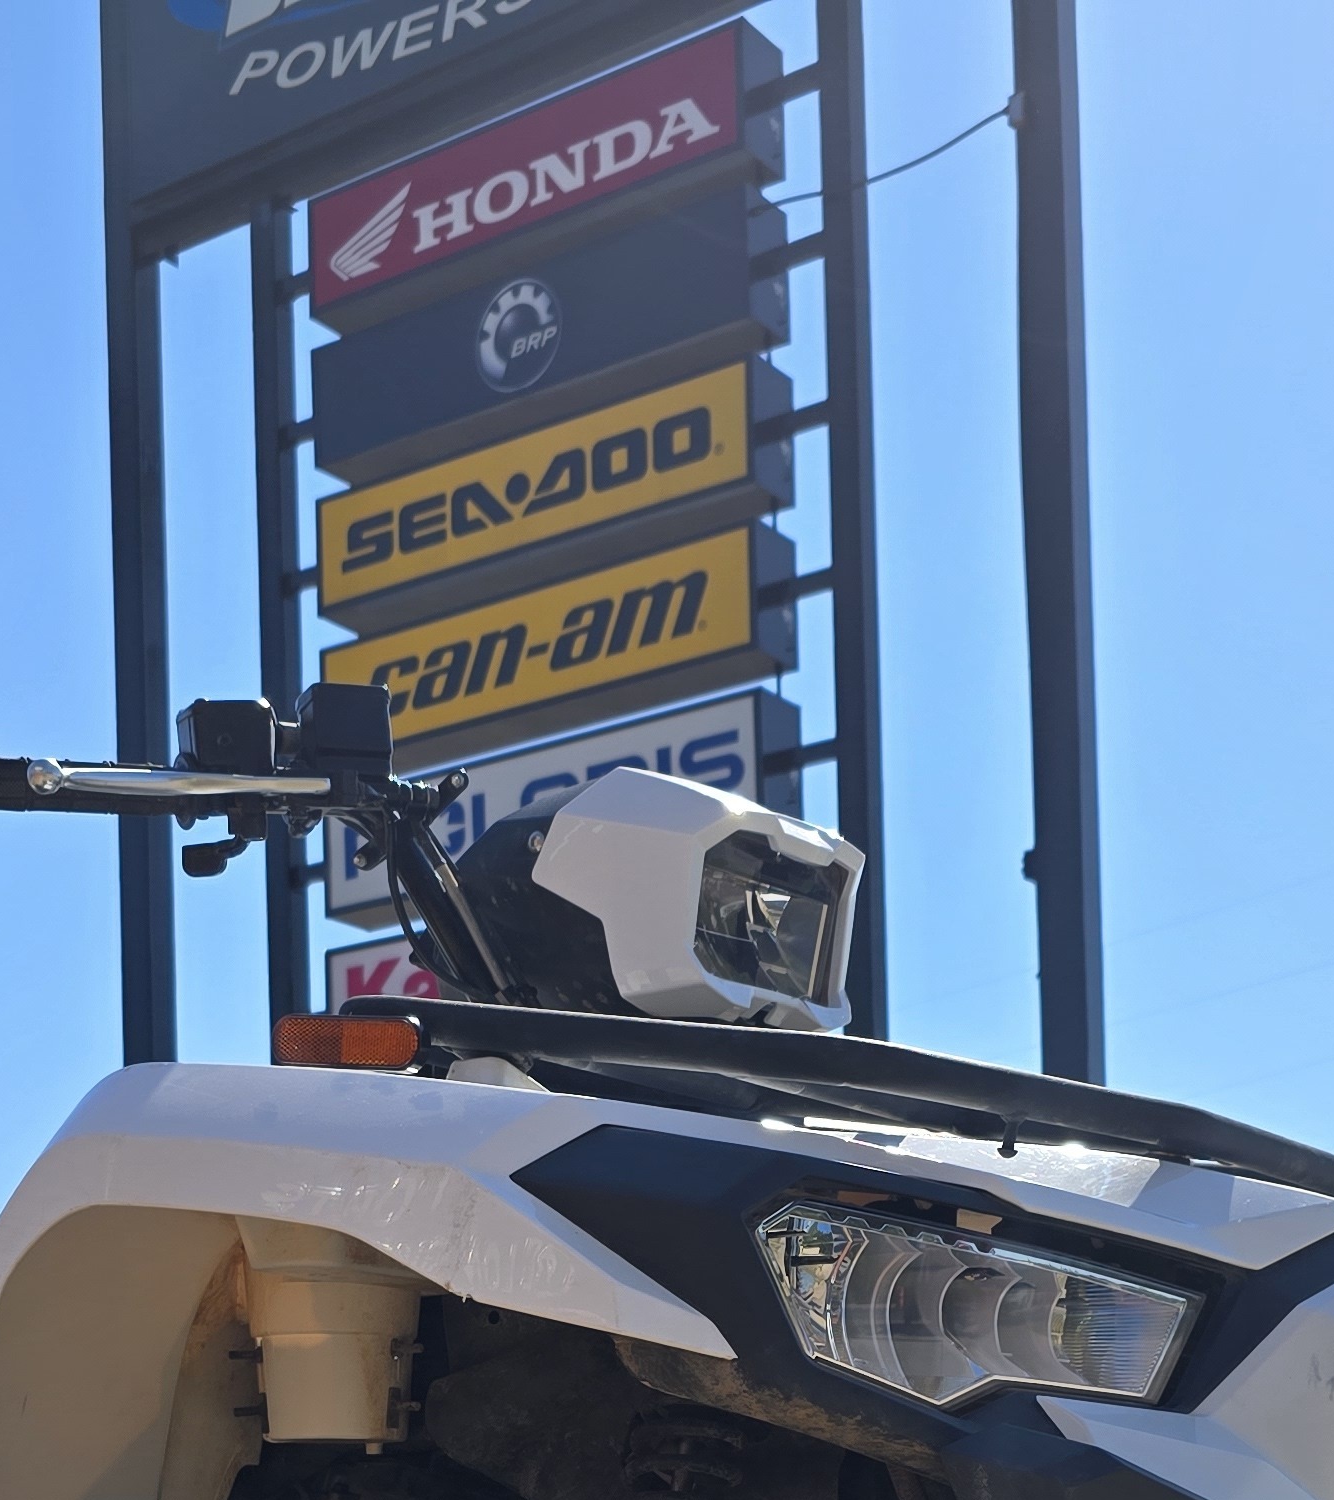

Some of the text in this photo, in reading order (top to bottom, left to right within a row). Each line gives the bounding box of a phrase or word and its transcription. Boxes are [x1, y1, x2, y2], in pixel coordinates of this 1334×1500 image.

[228, 0, 532, 96] POWER
[412, 97, 720, 254] HONDA
[510, 325, 558, 359] BRP
[369, 570, 708, 718] can-am
